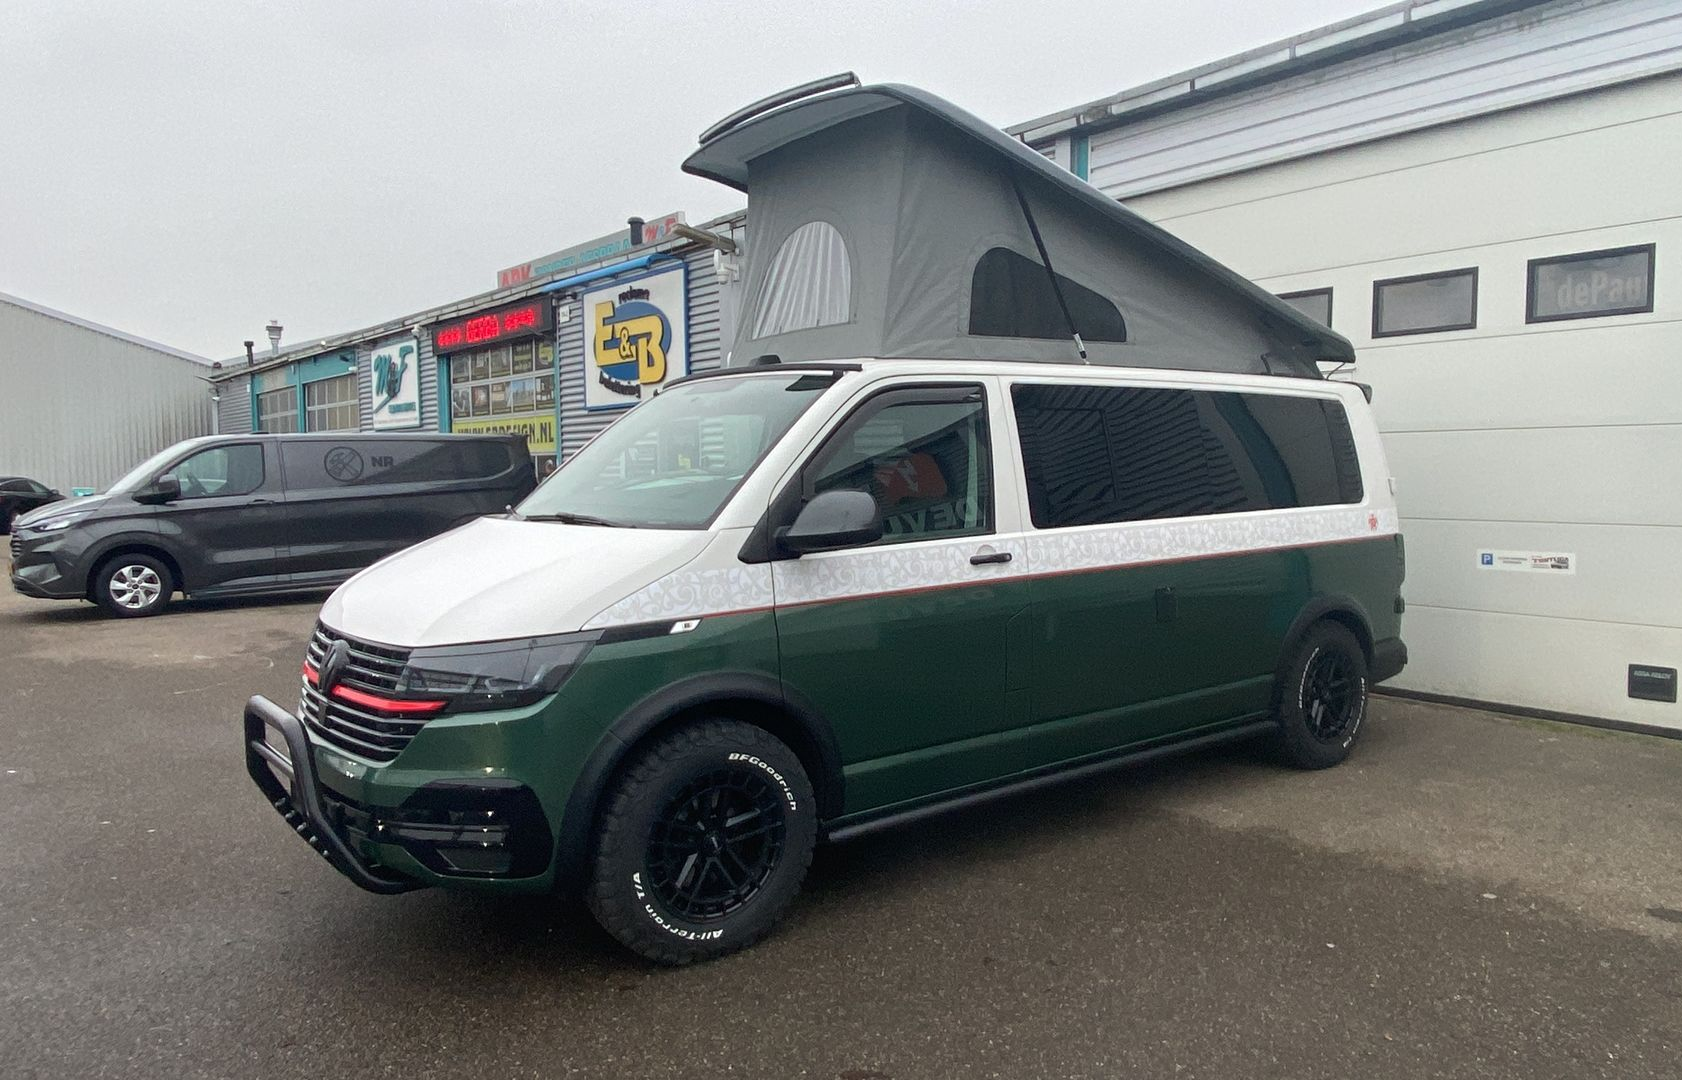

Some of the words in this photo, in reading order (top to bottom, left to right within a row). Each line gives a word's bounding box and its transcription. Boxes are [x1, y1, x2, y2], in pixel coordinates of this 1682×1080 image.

[594, 300, 668, 385] E&B
[370, 455, 394, 467] NR
[728, 752, 797, 811] BFGoodrich
[632, 872, 646, 900] T/A
[645, 904, 724, 941] All-Terrain
